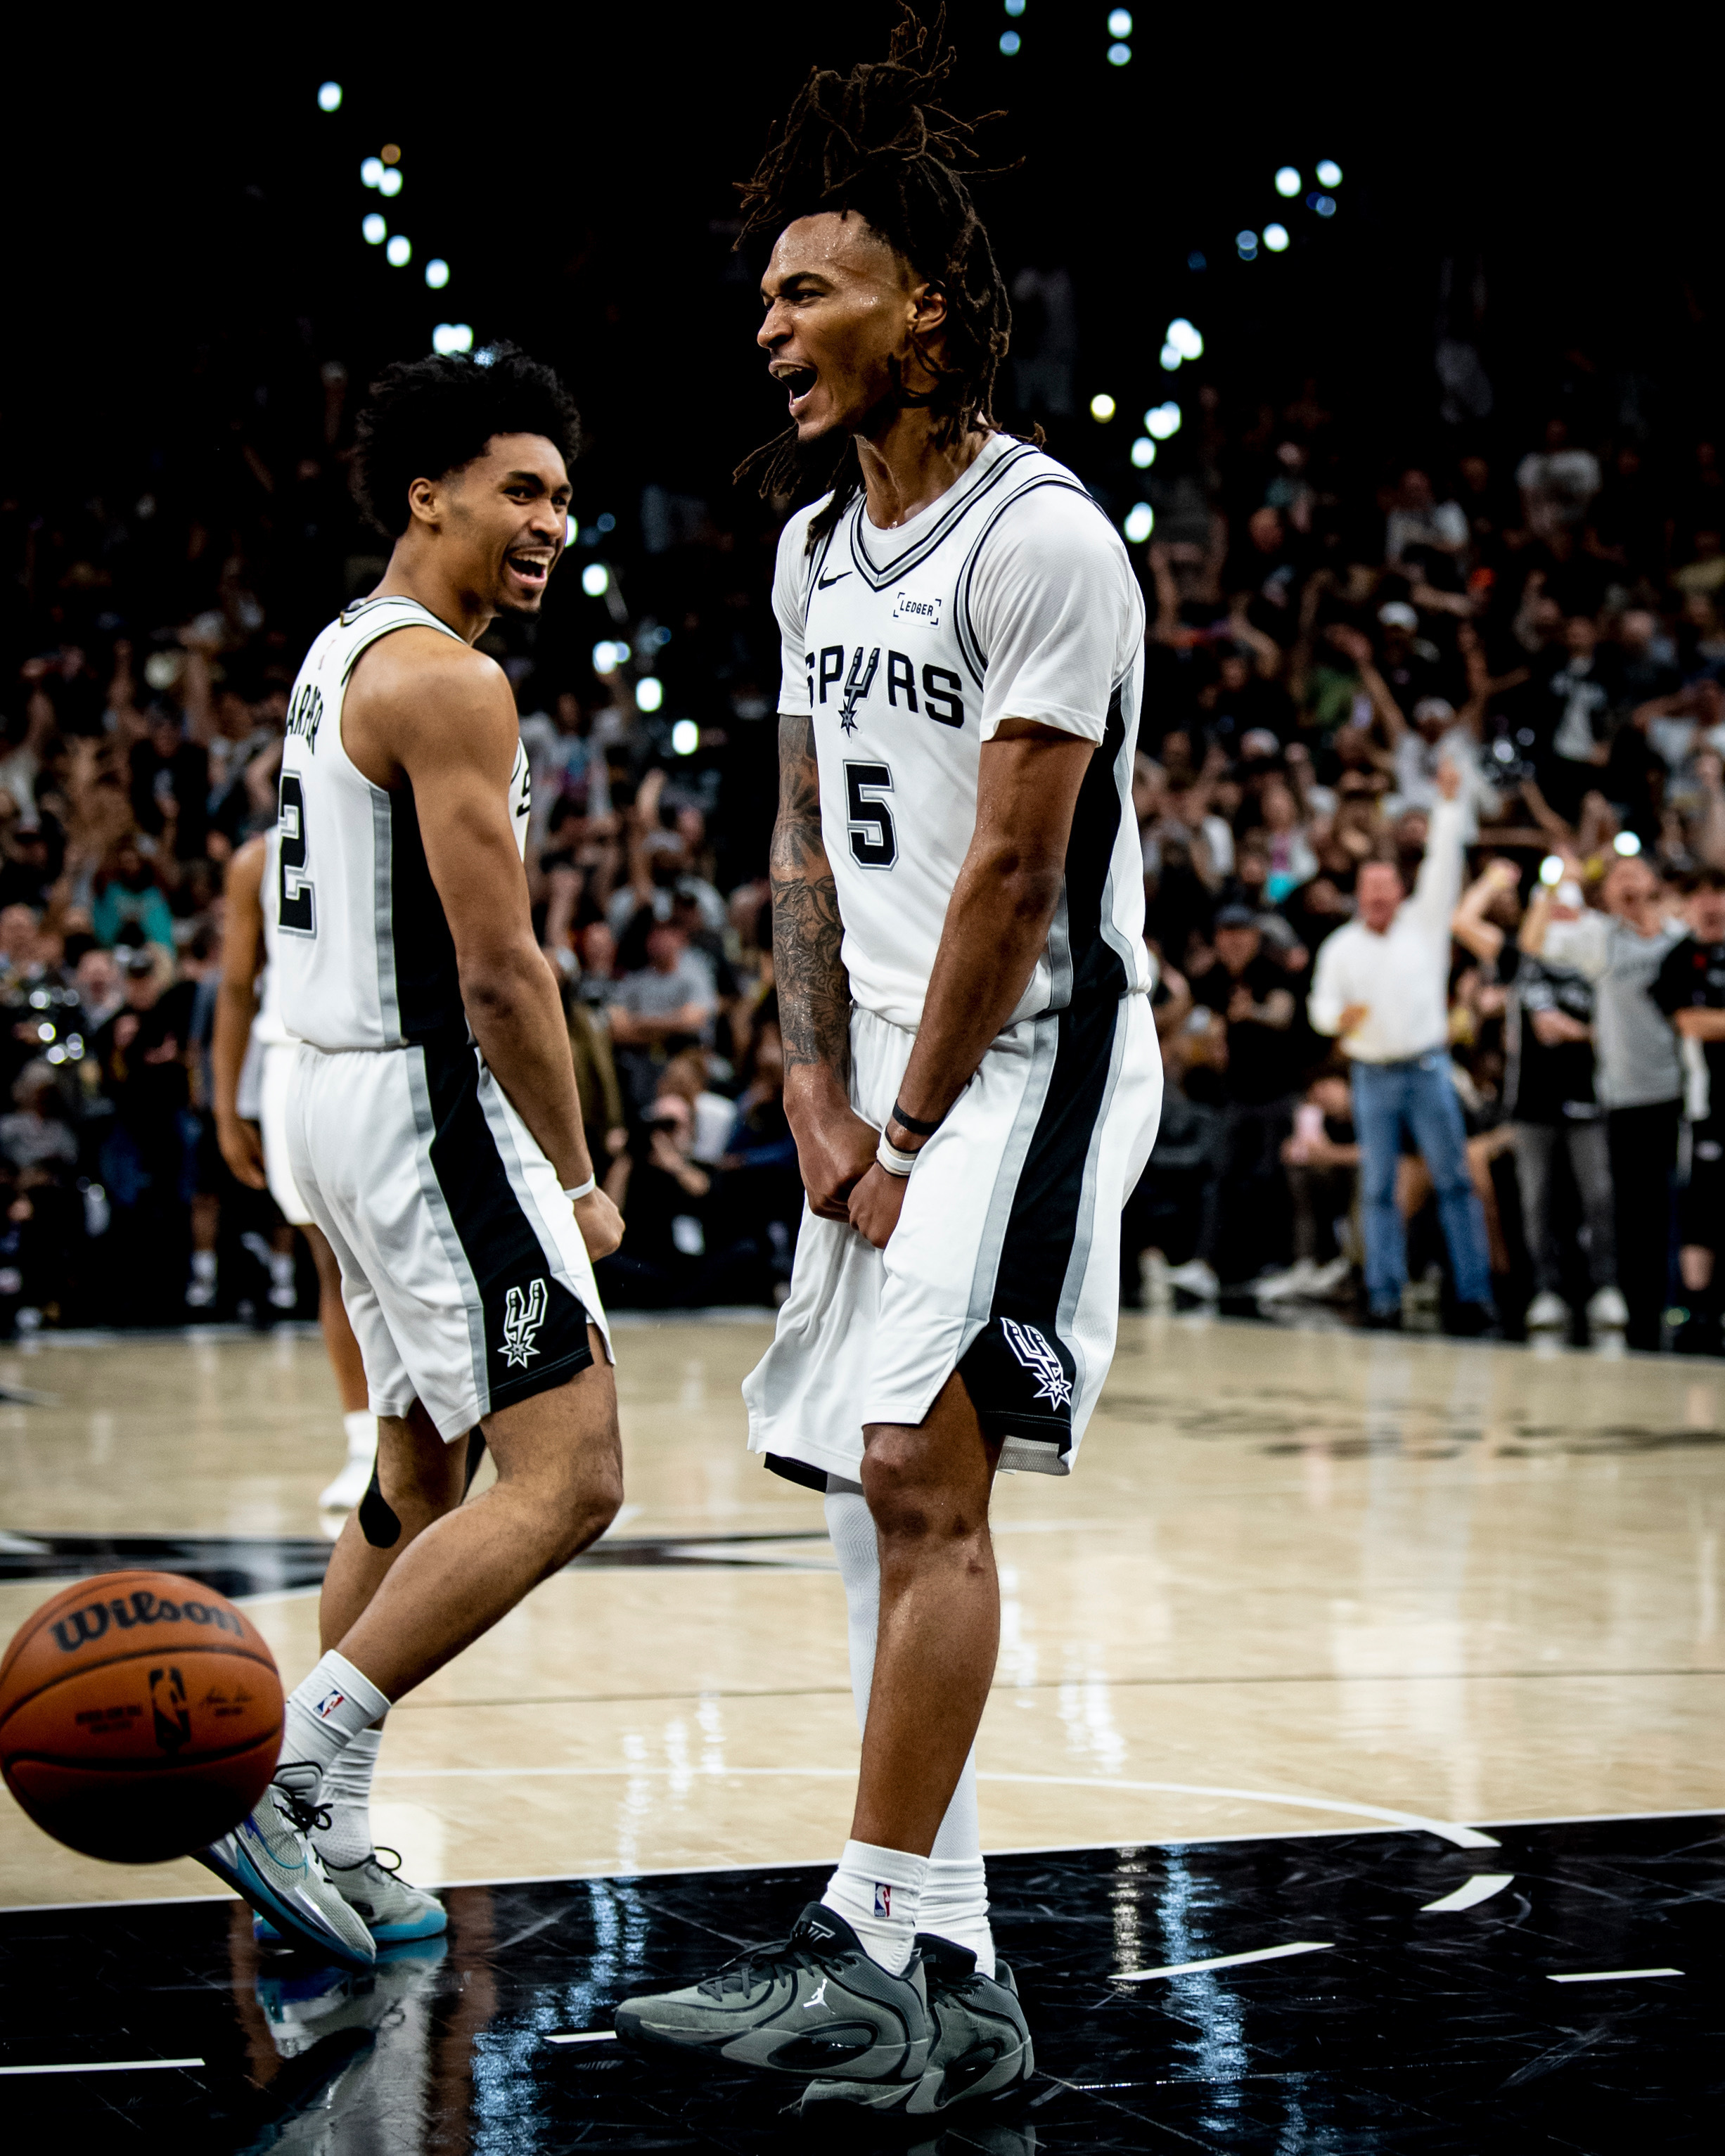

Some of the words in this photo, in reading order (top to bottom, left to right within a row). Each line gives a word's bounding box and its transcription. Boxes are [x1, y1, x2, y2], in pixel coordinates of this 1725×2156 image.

[899, 599, 934, 617] LEDGER
[278, 768, 317, 940] 2
[842, 759, 899, 871] 5
[49, 1591, 244, 1653] Wilson
